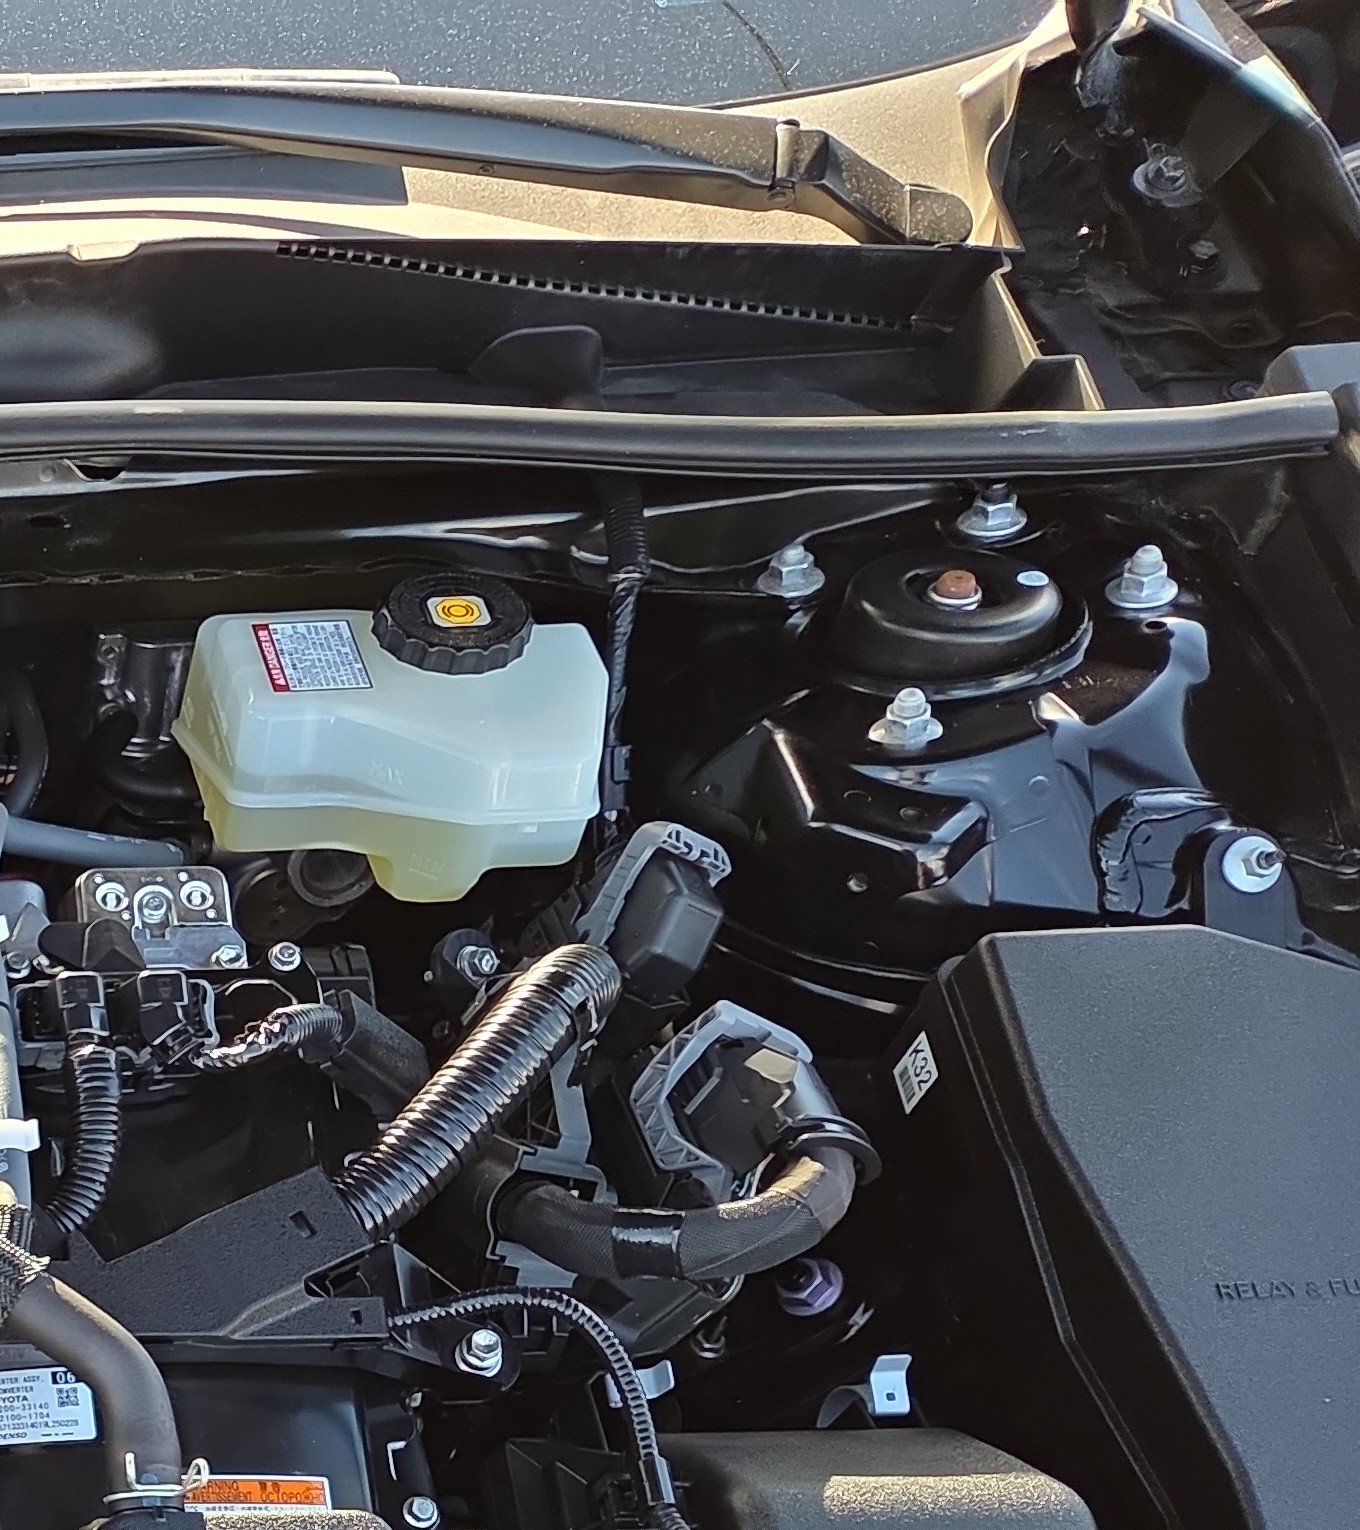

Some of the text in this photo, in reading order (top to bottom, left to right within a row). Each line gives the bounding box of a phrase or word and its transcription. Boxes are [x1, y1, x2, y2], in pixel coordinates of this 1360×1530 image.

[909, 1040, 932, 1092] K32
[1215, 1281, 1295, 1299] RELAY
[55, 1371, 76, 1384] 06
